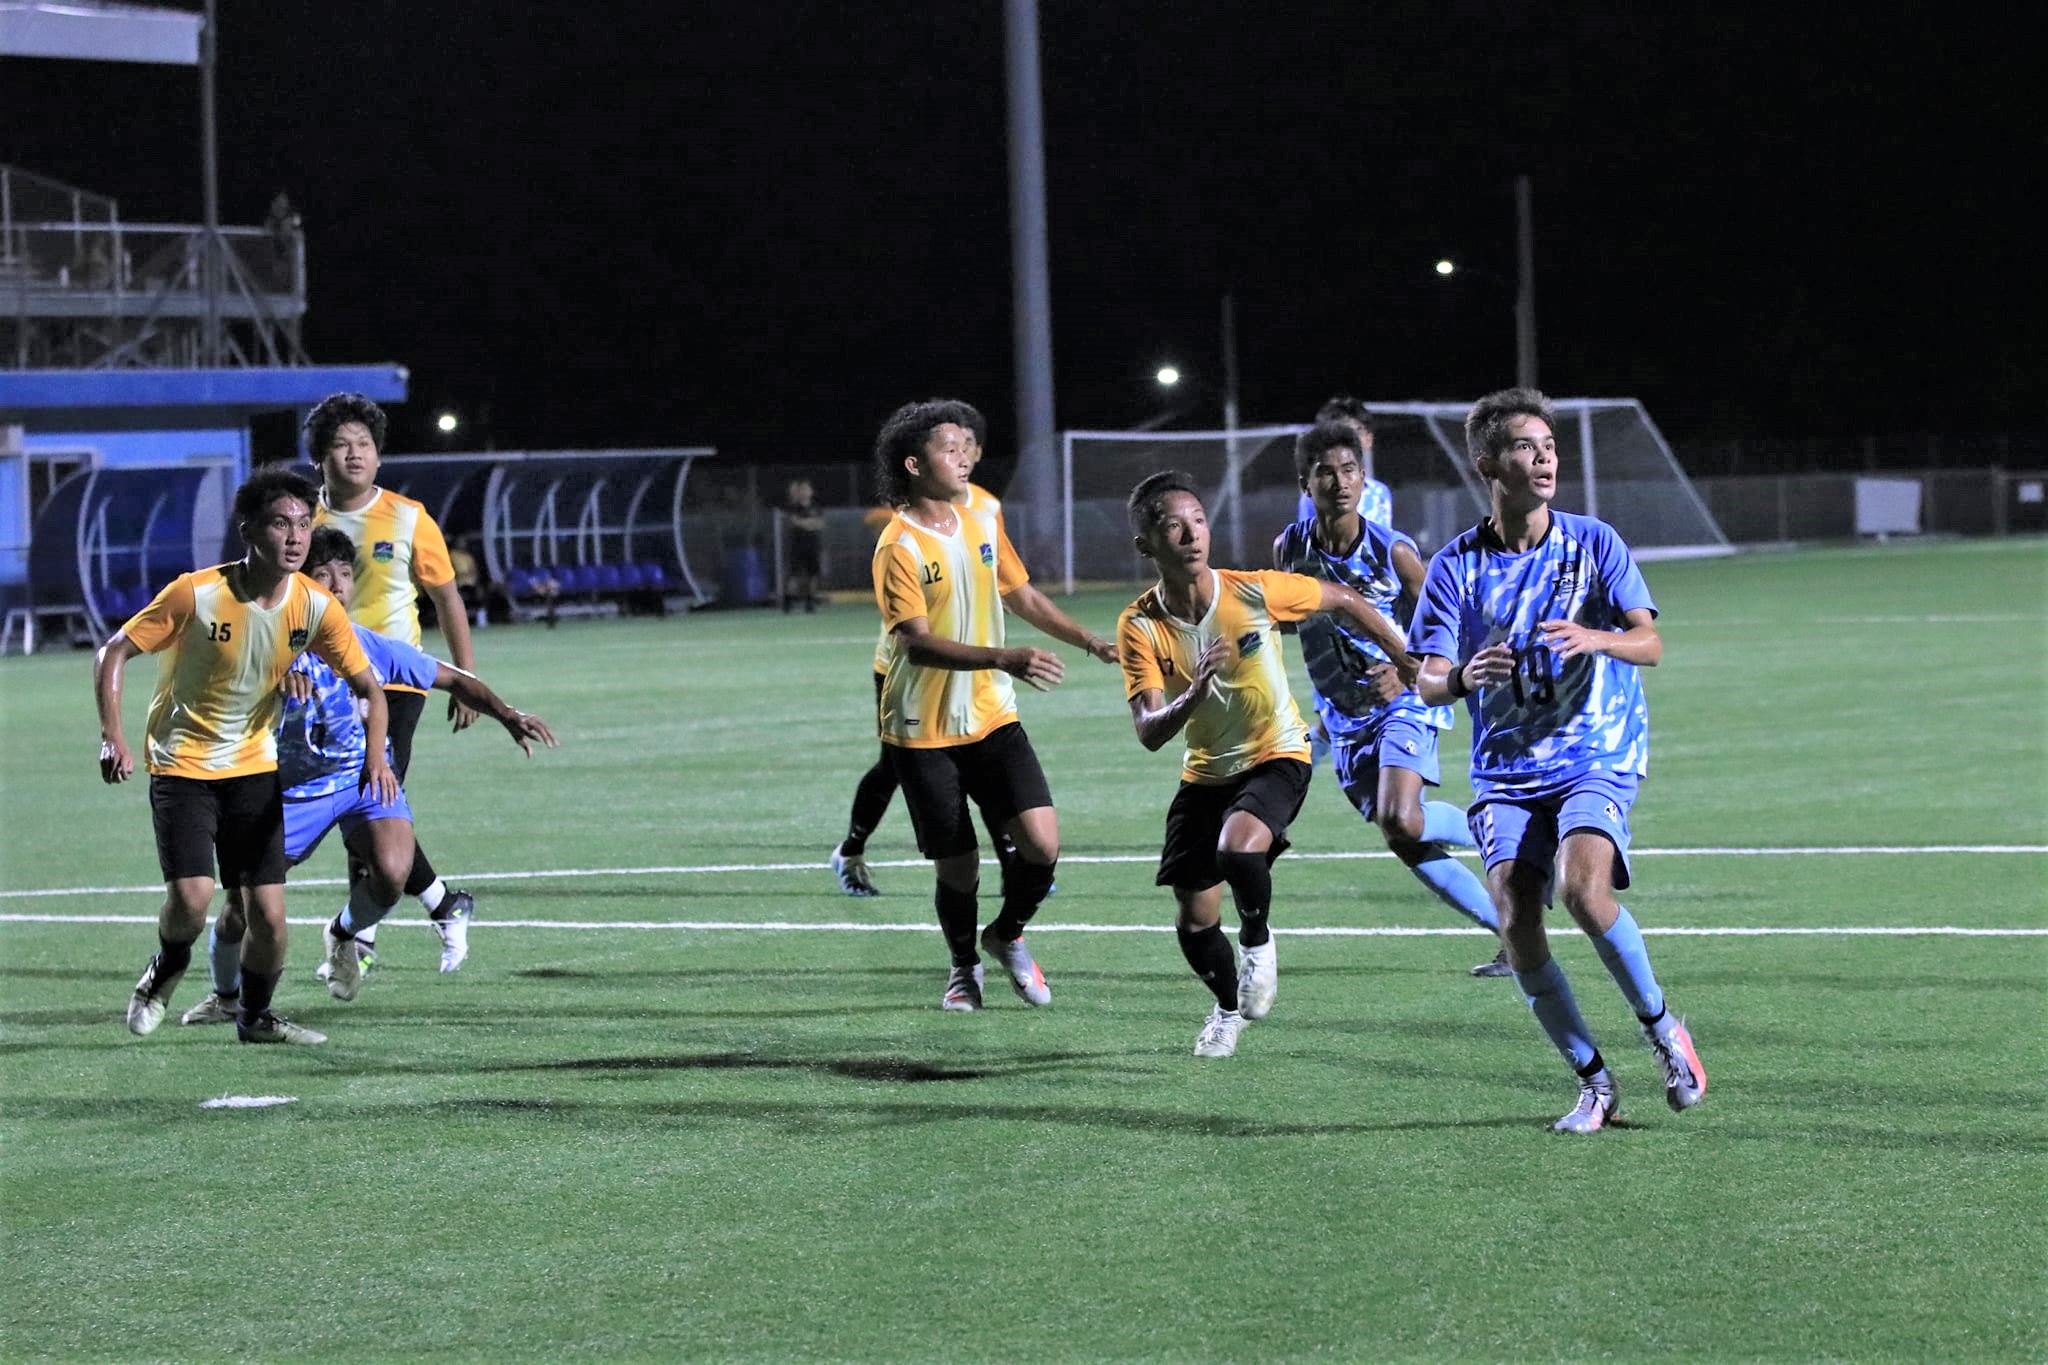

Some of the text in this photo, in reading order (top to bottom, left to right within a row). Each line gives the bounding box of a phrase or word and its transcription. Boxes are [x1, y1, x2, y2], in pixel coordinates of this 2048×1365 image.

[924, 561, 943, 585] 12
[208, 622, 232, 642] 15
[1509, 644, 1556, 708] 19
